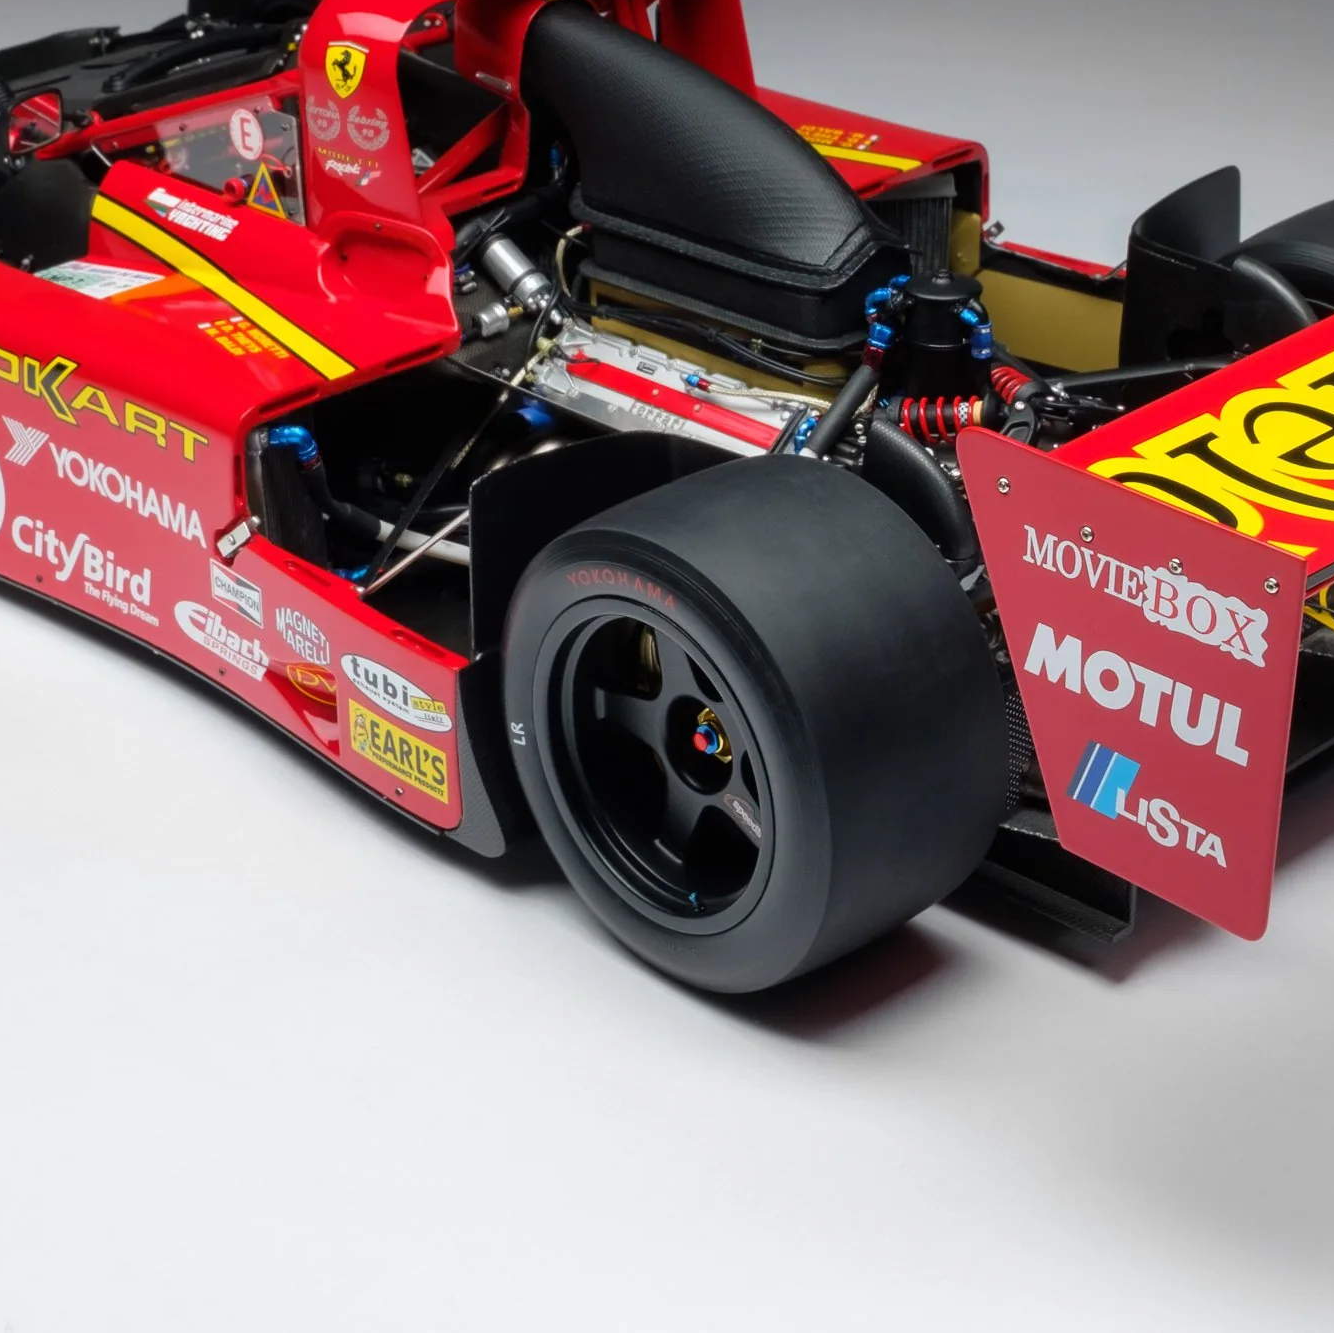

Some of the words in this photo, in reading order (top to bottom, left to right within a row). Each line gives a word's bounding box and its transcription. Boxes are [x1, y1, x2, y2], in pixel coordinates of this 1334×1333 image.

[238, 117, 255, 152] E
[168, 208, 232, 242] YACHTING
[48, 441, 207, 549] YOKOHAMA
[11, 515, 152, 607] CityBird
[83, 581, 101, 600] The
[102, 590, 129, 615] Flying
[130, 603, 160, 627] Dream
[214, 576, 260, 614] CHAMPION
[567, 568, 676, 609] YOKOHAMA
[174, 600, 269, 667] Eibach
[203, 635, 259, 675] SPRINGS
[350, 655, 409, 709] tubi
[1023, 622, 1250, 768] MOTUL
[412, 698, 444, 713] style
[369, 719, 446, 786] EARL'S
[510, 721, 527, 746] LR
[371, 749, 413, 780] PERFORMANCE
[413, 772, 445, 798] PRODUCTS
